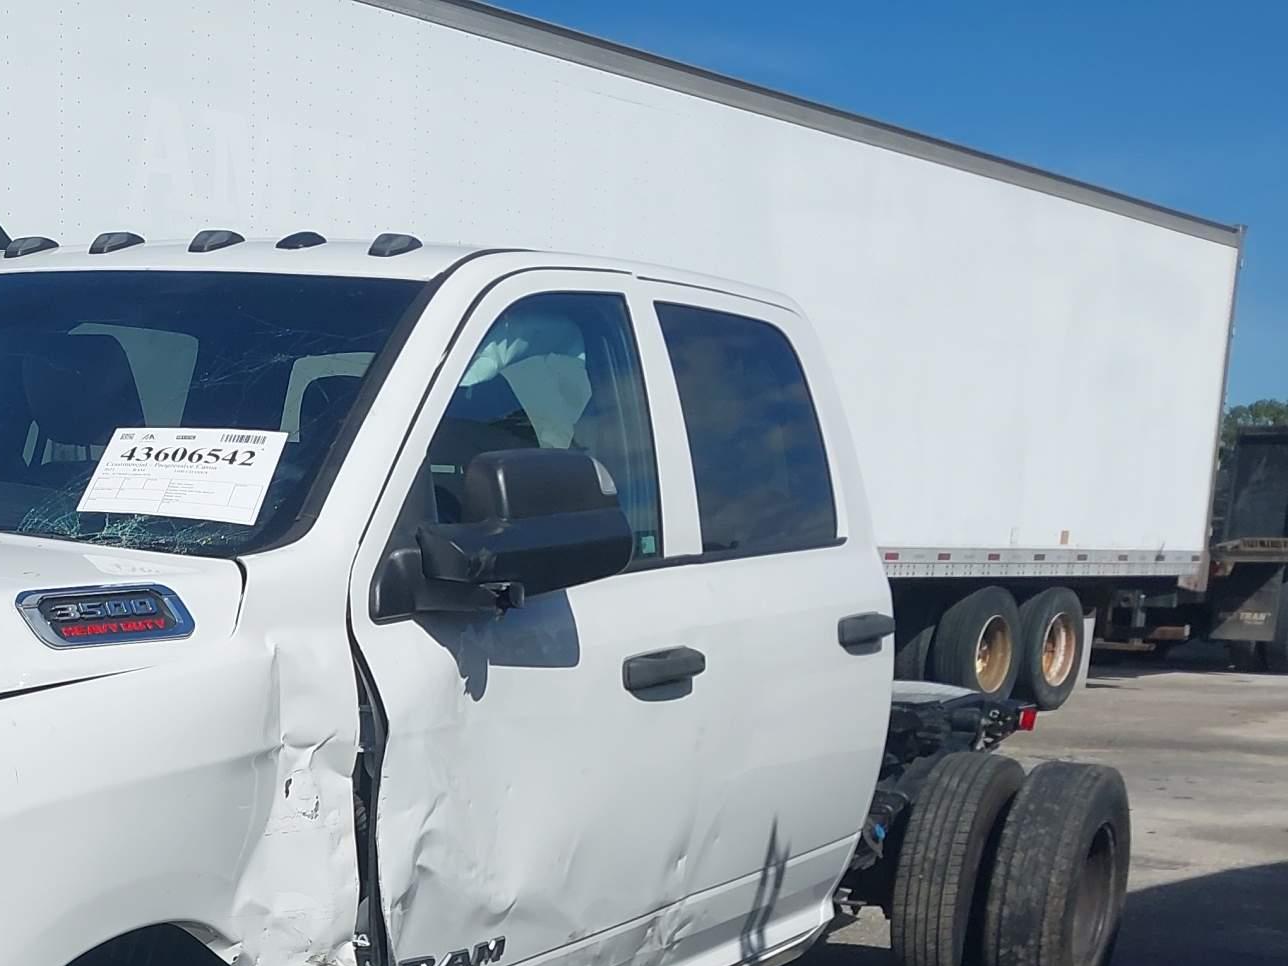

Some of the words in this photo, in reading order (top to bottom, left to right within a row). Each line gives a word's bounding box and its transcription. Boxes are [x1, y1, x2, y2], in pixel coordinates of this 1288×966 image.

[120, 445, 256, 467] 43606542
[50, 597, 157, 622] 3500
[61, 622, 117, 637] HEAVY
[121, 619, 165, 633] DUTY
